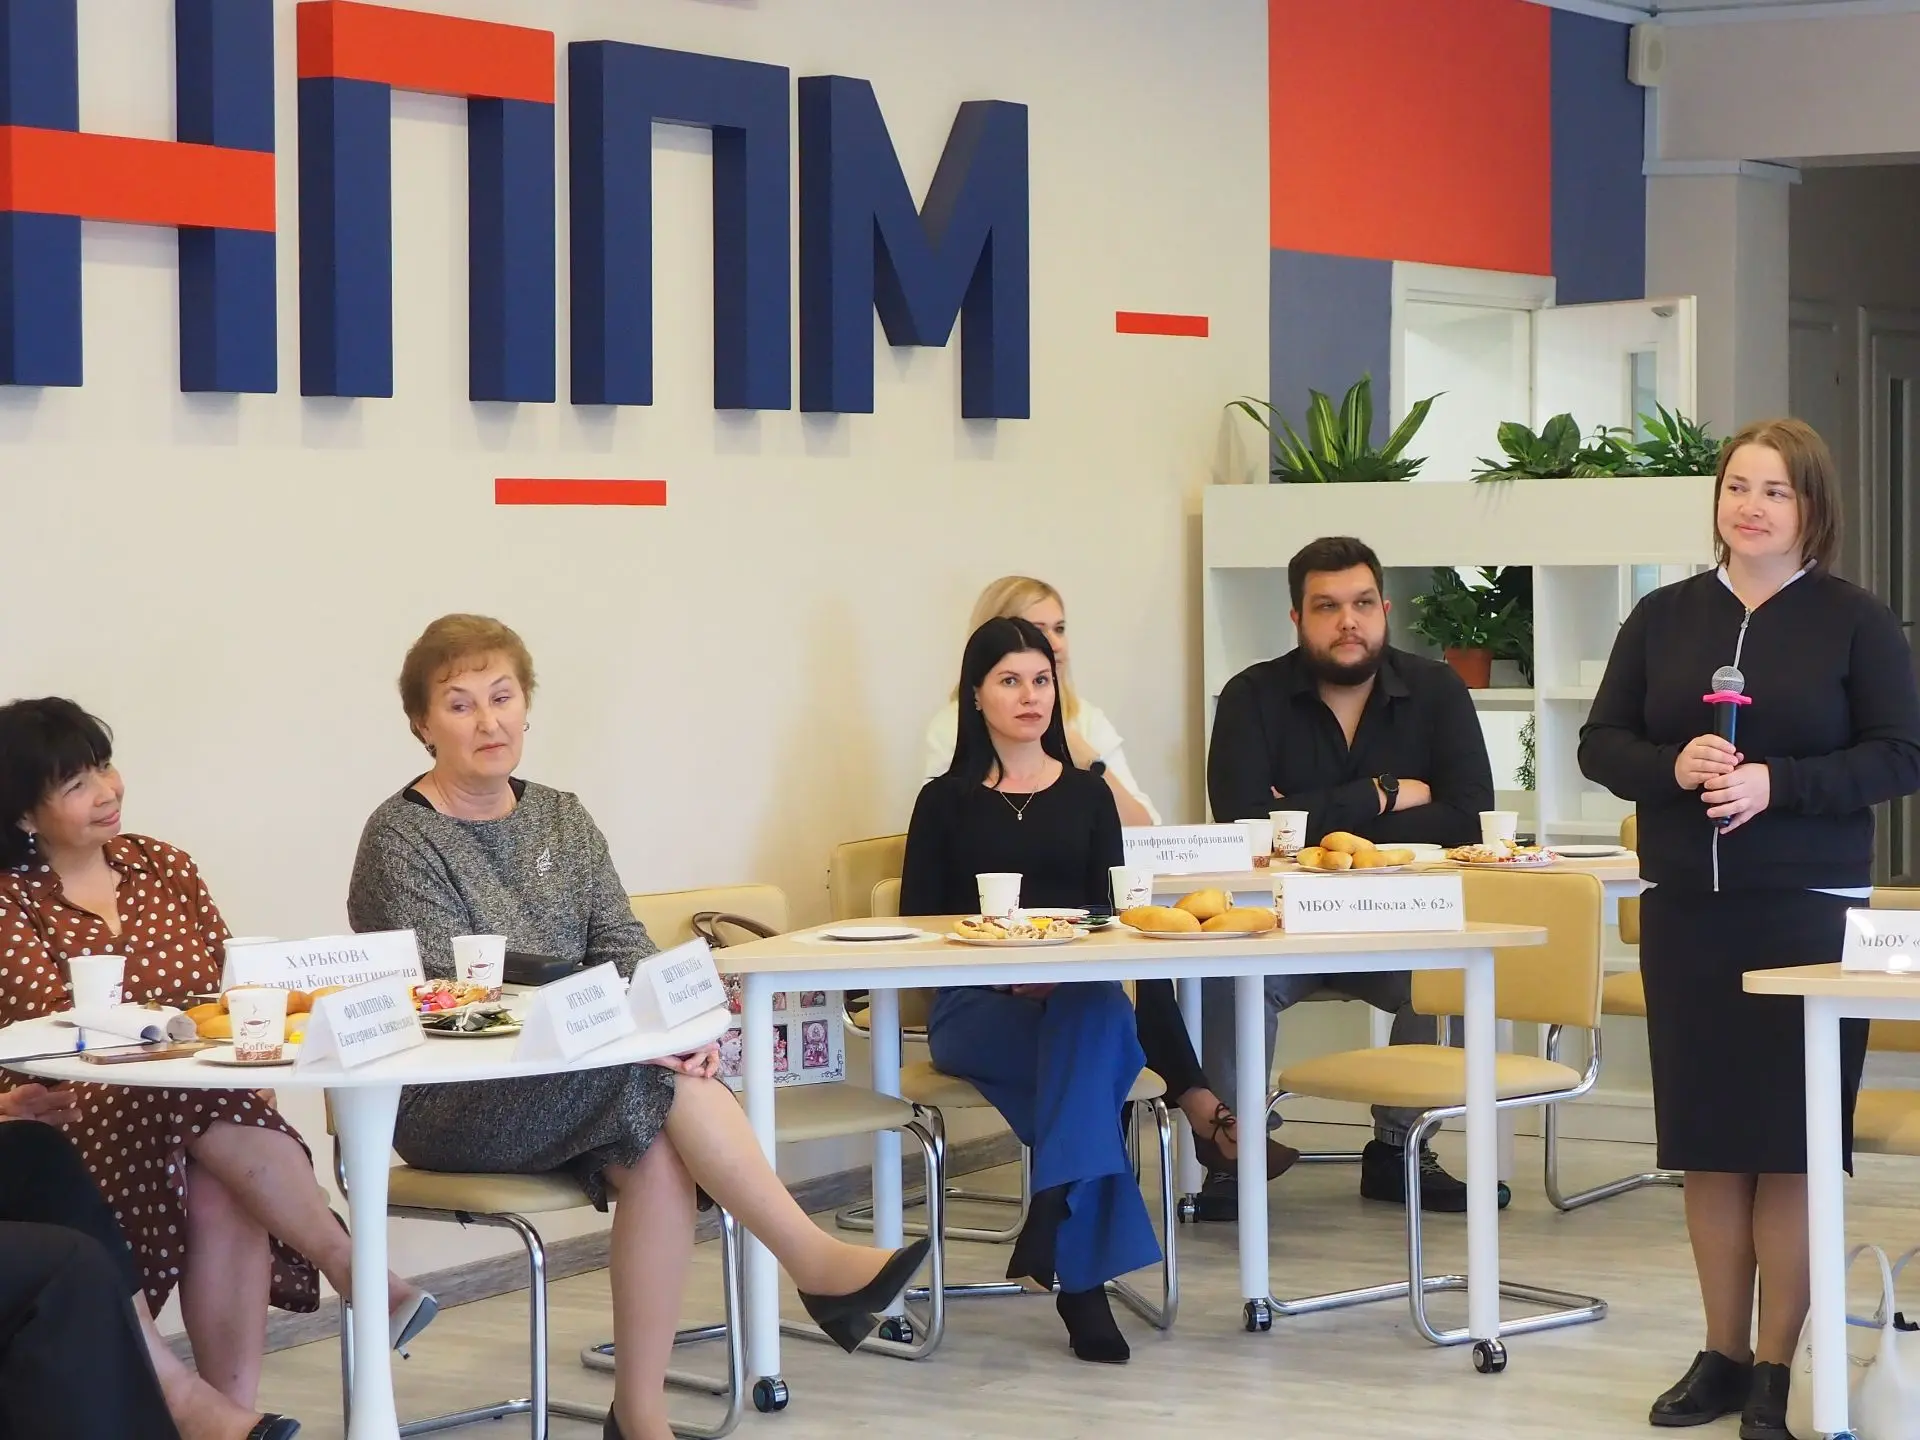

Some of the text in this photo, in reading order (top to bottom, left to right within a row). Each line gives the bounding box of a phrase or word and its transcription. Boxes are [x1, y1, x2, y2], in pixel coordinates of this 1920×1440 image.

[1138, 835, 1186, 849] цифрового
[1188, 834, 1244, 847] образования
[1156, 850, 1199, 862] «ИТ-куб»
[1298, 898, 1454, 912] МБОУ «Школа № 62»
[1859, 934, 1909, 948] МБОУ
[286, 949, 370, 969] ХАРЬКОВА
[566, 984, 606, 1010] ИГНАТОВА
[343, 994, 396, 1020] ФИЛИППОВА
[337, 1026, 378, 1048] Екатерина
[242, 1042, 275, 1051] Coffee
